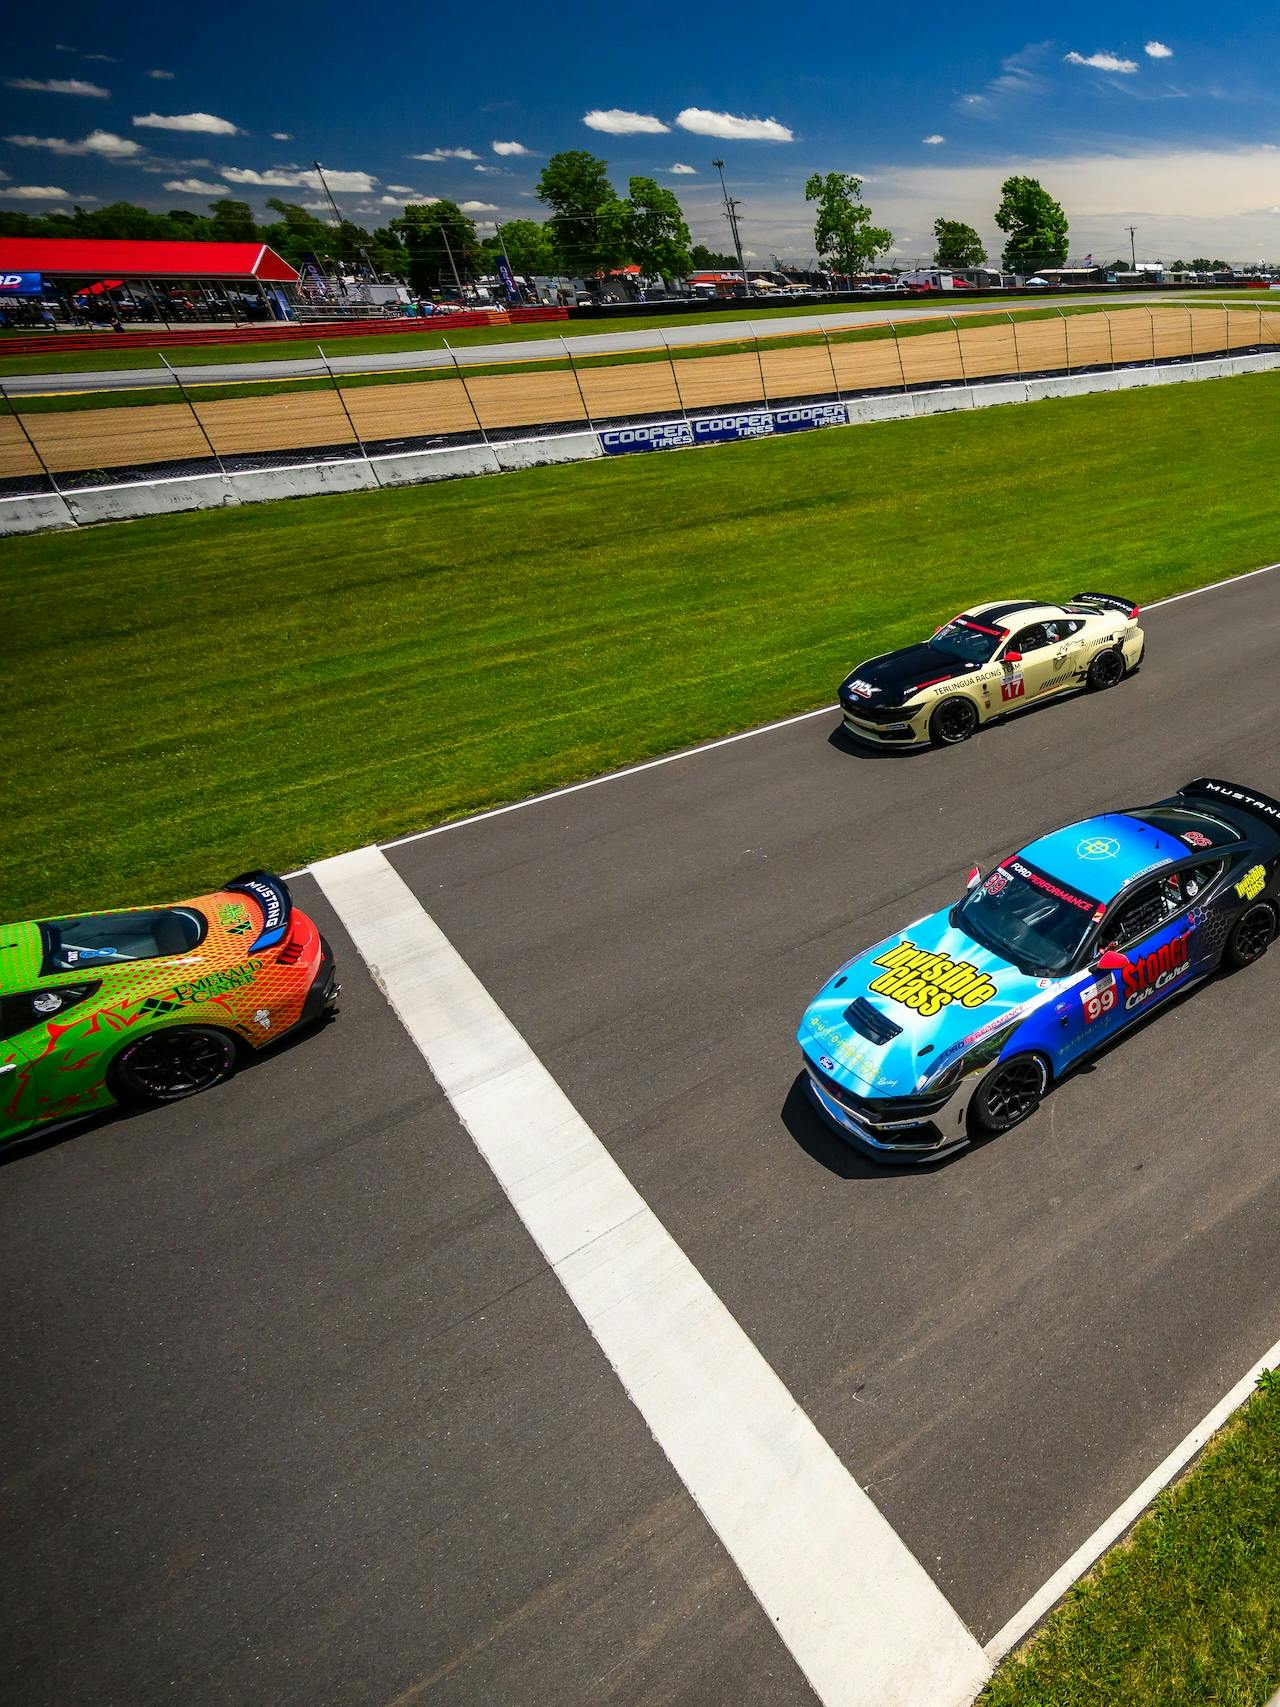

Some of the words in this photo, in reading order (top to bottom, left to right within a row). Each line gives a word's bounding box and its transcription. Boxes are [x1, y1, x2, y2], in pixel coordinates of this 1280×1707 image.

[696, 413, 773, 433] COOPER
[776, 405, 845, 424] COOPER
[812, 414, 846, 427] TIRES
[603, 422, 692, 445] COOPER
[650, 435, 692, 449] TIRES
[735, 424, 775, 437] TIRES
[934, 679, 975, 697] TERLINGUA
[975, 668, 1003, 683] RACING
[1002, 662, 1021, 675] TEAM
[1004, 680, 1021, 698] 17
[983, 872, 1007, 896] 99
[1011, 862, 1032, 879] FORD
[1028, 873, 1094, 912] PERFORMANCE
[1235, 864, 1267, 899] Invisible
[1246, 877, 1266, 900] Glass
[244, 881, 281, 928] MUSTANG
[172, 960, 263, 1001] EMERALD
[872, 941, 998, 1008] Invisible
[1121, 937, 1189, 998] Stoner
[191, 975, 256, 1003] CENTER
[868, 966, 953, 1017] Glass
[1039, 979, 1047, 988] E
[1124, 987, 1155, 1011] Car
[1155, 960, 1191, 989] Care
[1088, 989, 1115, 1020] 99
[940, 1042, 965, 1060] FORD
[962, 1004, 1024, 1044] PERFORMANCE
